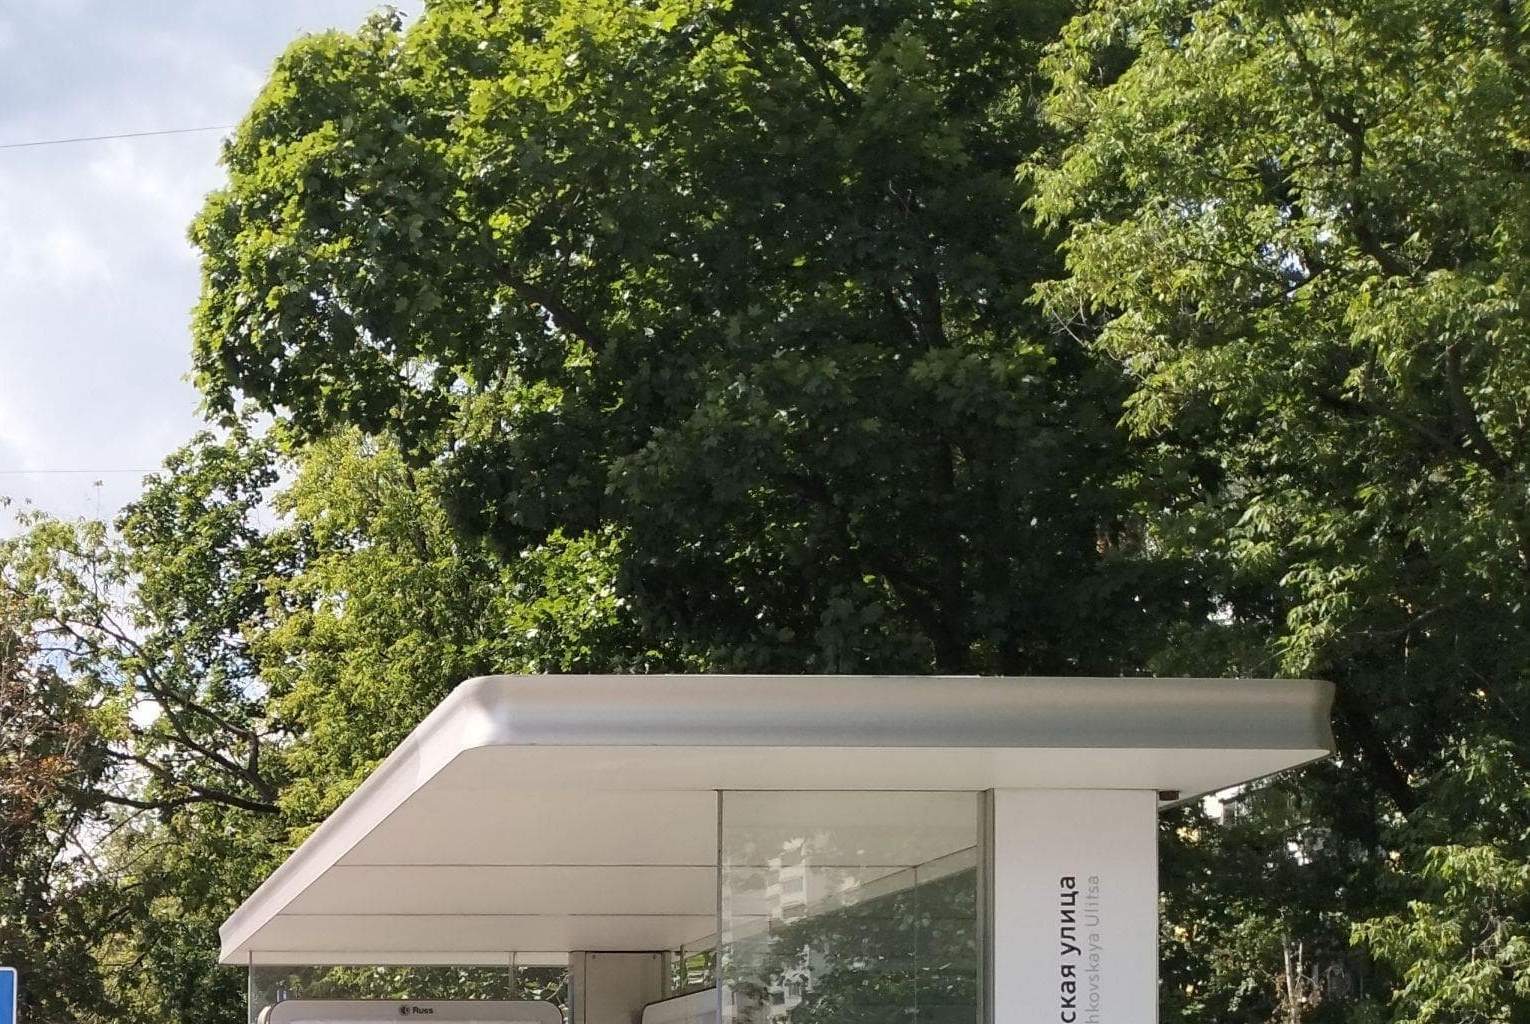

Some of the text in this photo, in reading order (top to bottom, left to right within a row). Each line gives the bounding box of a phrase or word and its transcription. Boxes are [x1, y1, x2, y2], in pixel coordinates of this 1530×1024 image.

[1060, 876, 1081, 956] улица
[1085, 875, 1100, 927] Ulitsa
[412, 1006, 434, 1014] Russ
